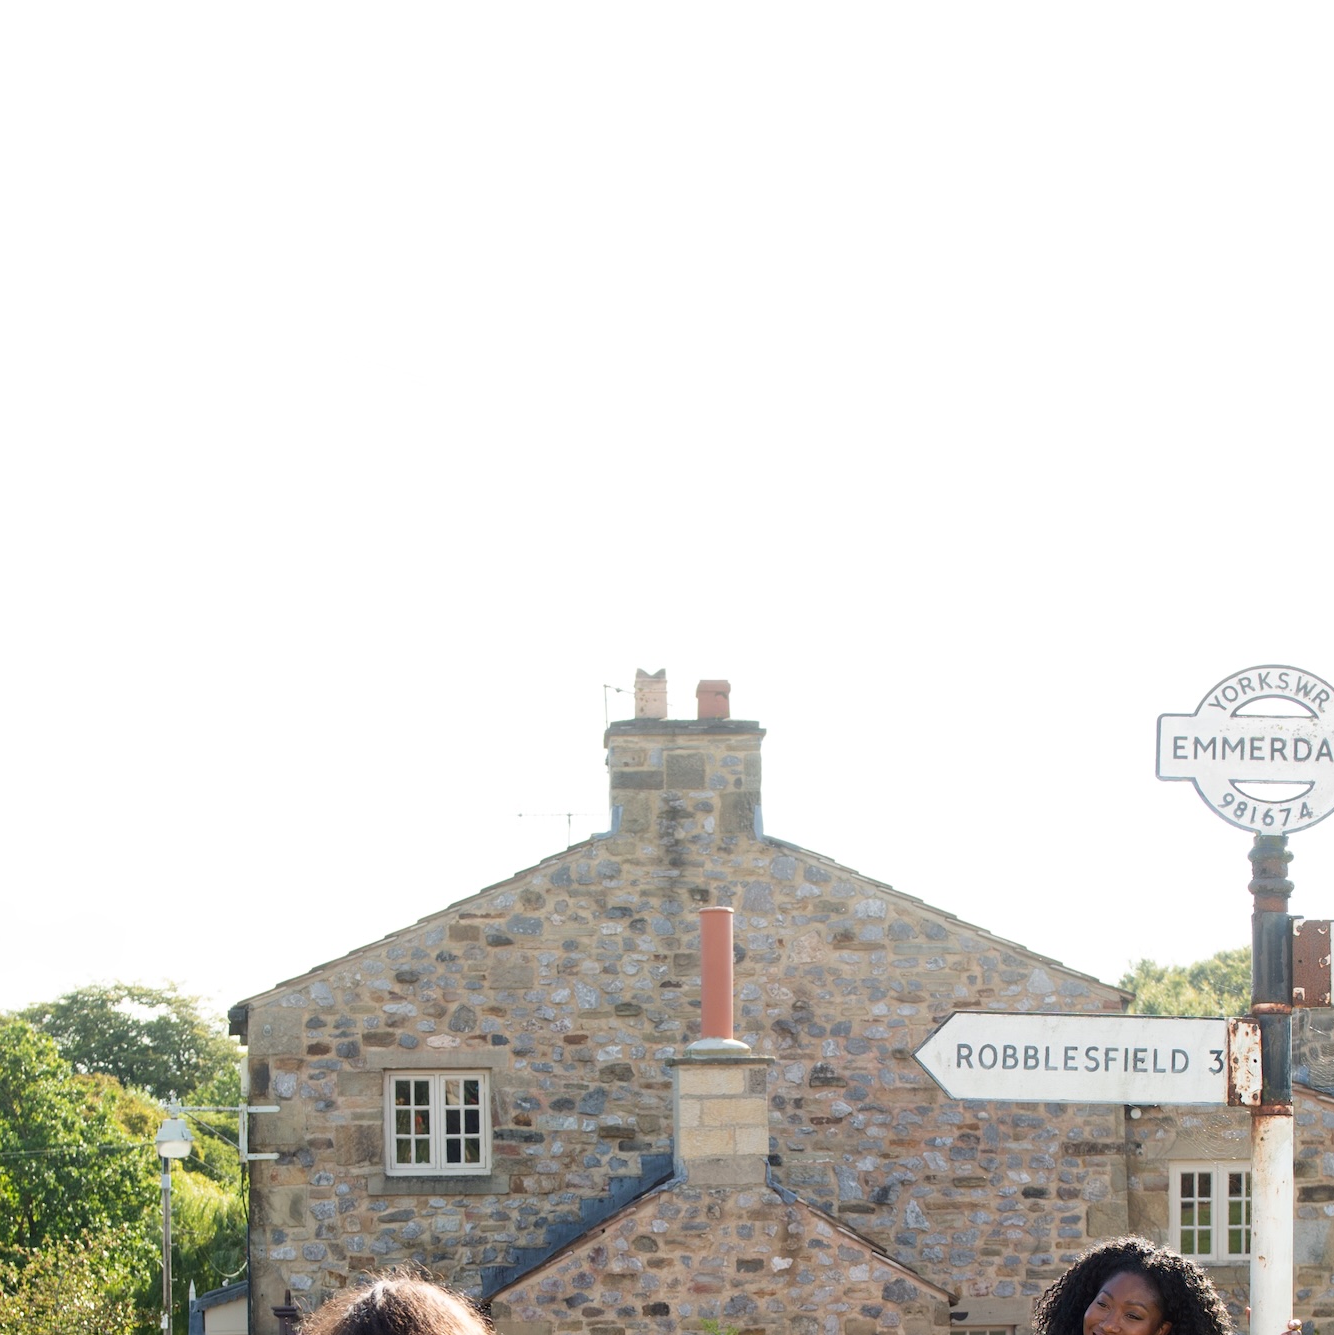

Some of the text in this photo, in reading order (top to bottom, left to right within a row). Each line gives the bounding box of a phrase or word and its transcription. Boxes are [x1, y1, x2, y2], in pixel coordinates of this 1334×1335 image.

[1217, 792, 1314, 827] 981674
[955, 1043, 1224, 1075] ROBBLESFIELD 3
